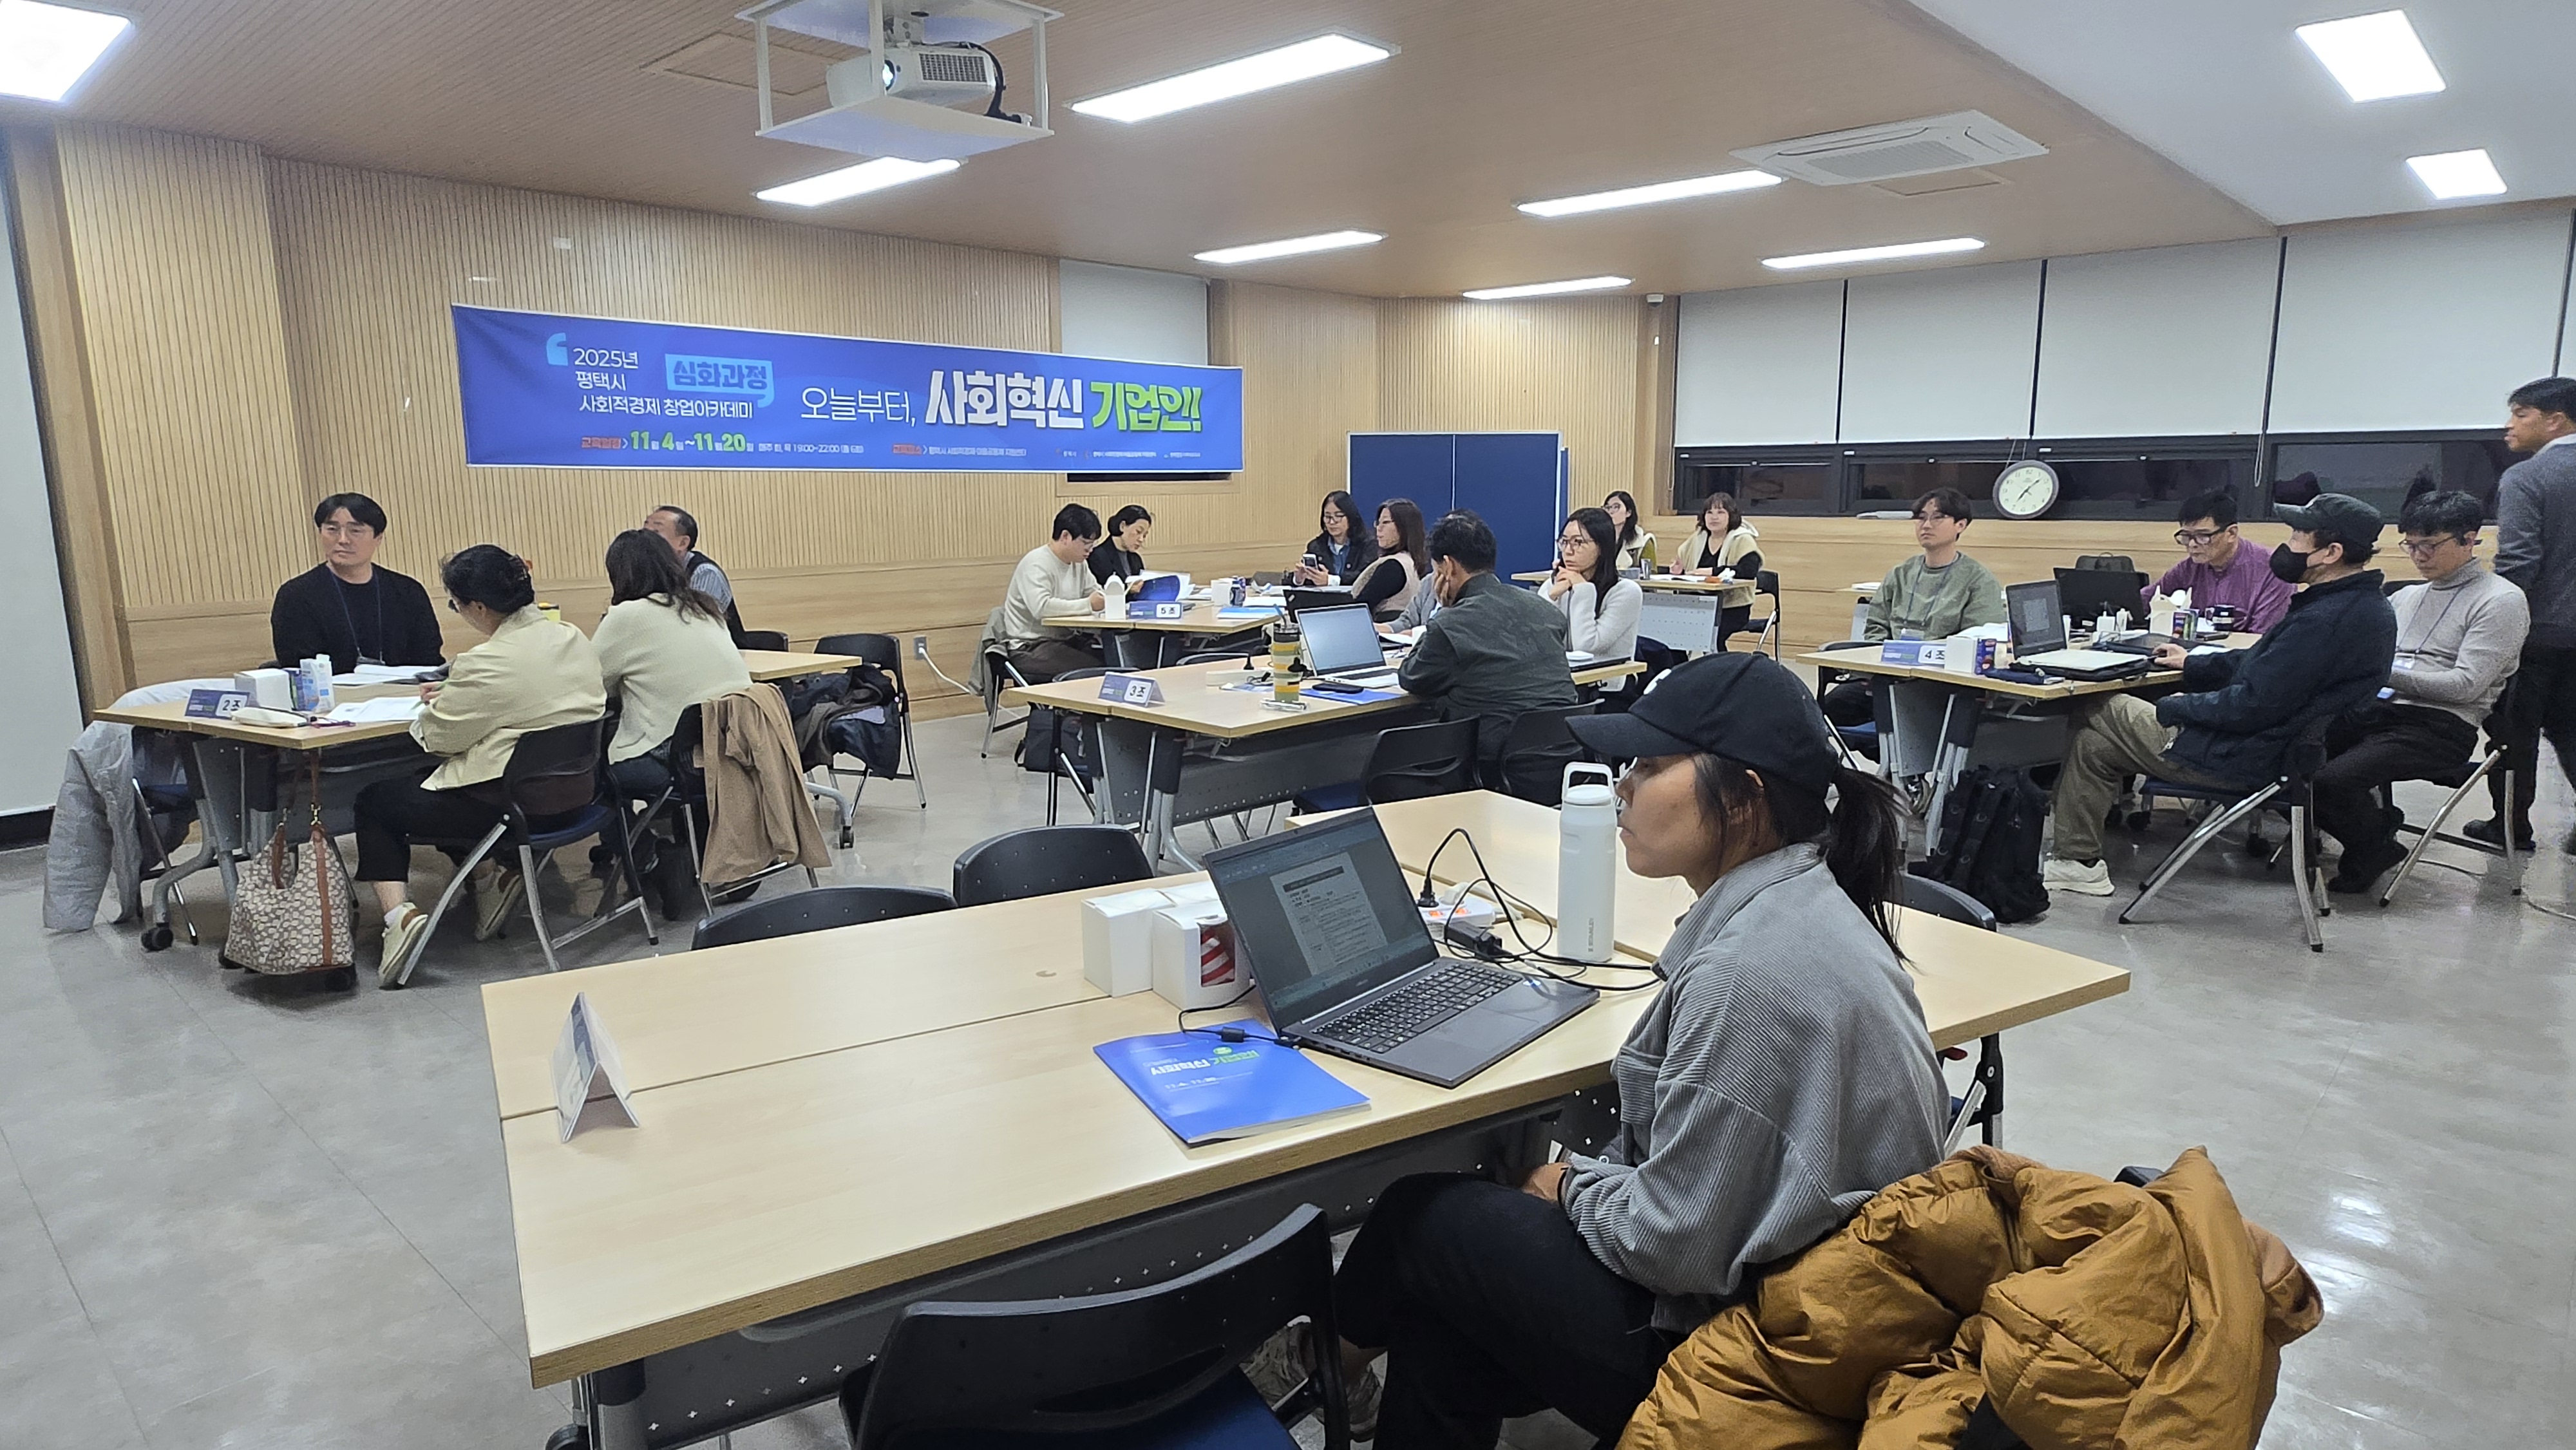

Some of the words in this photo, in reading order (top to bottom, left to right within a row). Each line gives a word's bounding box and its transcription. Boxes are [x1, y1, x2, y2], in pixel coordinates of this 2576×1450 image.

[573, 348, 638, 369] 2025년
[575, 371, 627, 391] 평택시
[673, 361, 768, 390] 심화과정
[579, 395, 661, 415] 사회적경제
[663, 398, 753, 419] 창업아카데미
[801, 387, 916, 427] 오늘부터,
[925, 370, 1084, 429] 사회혁신
